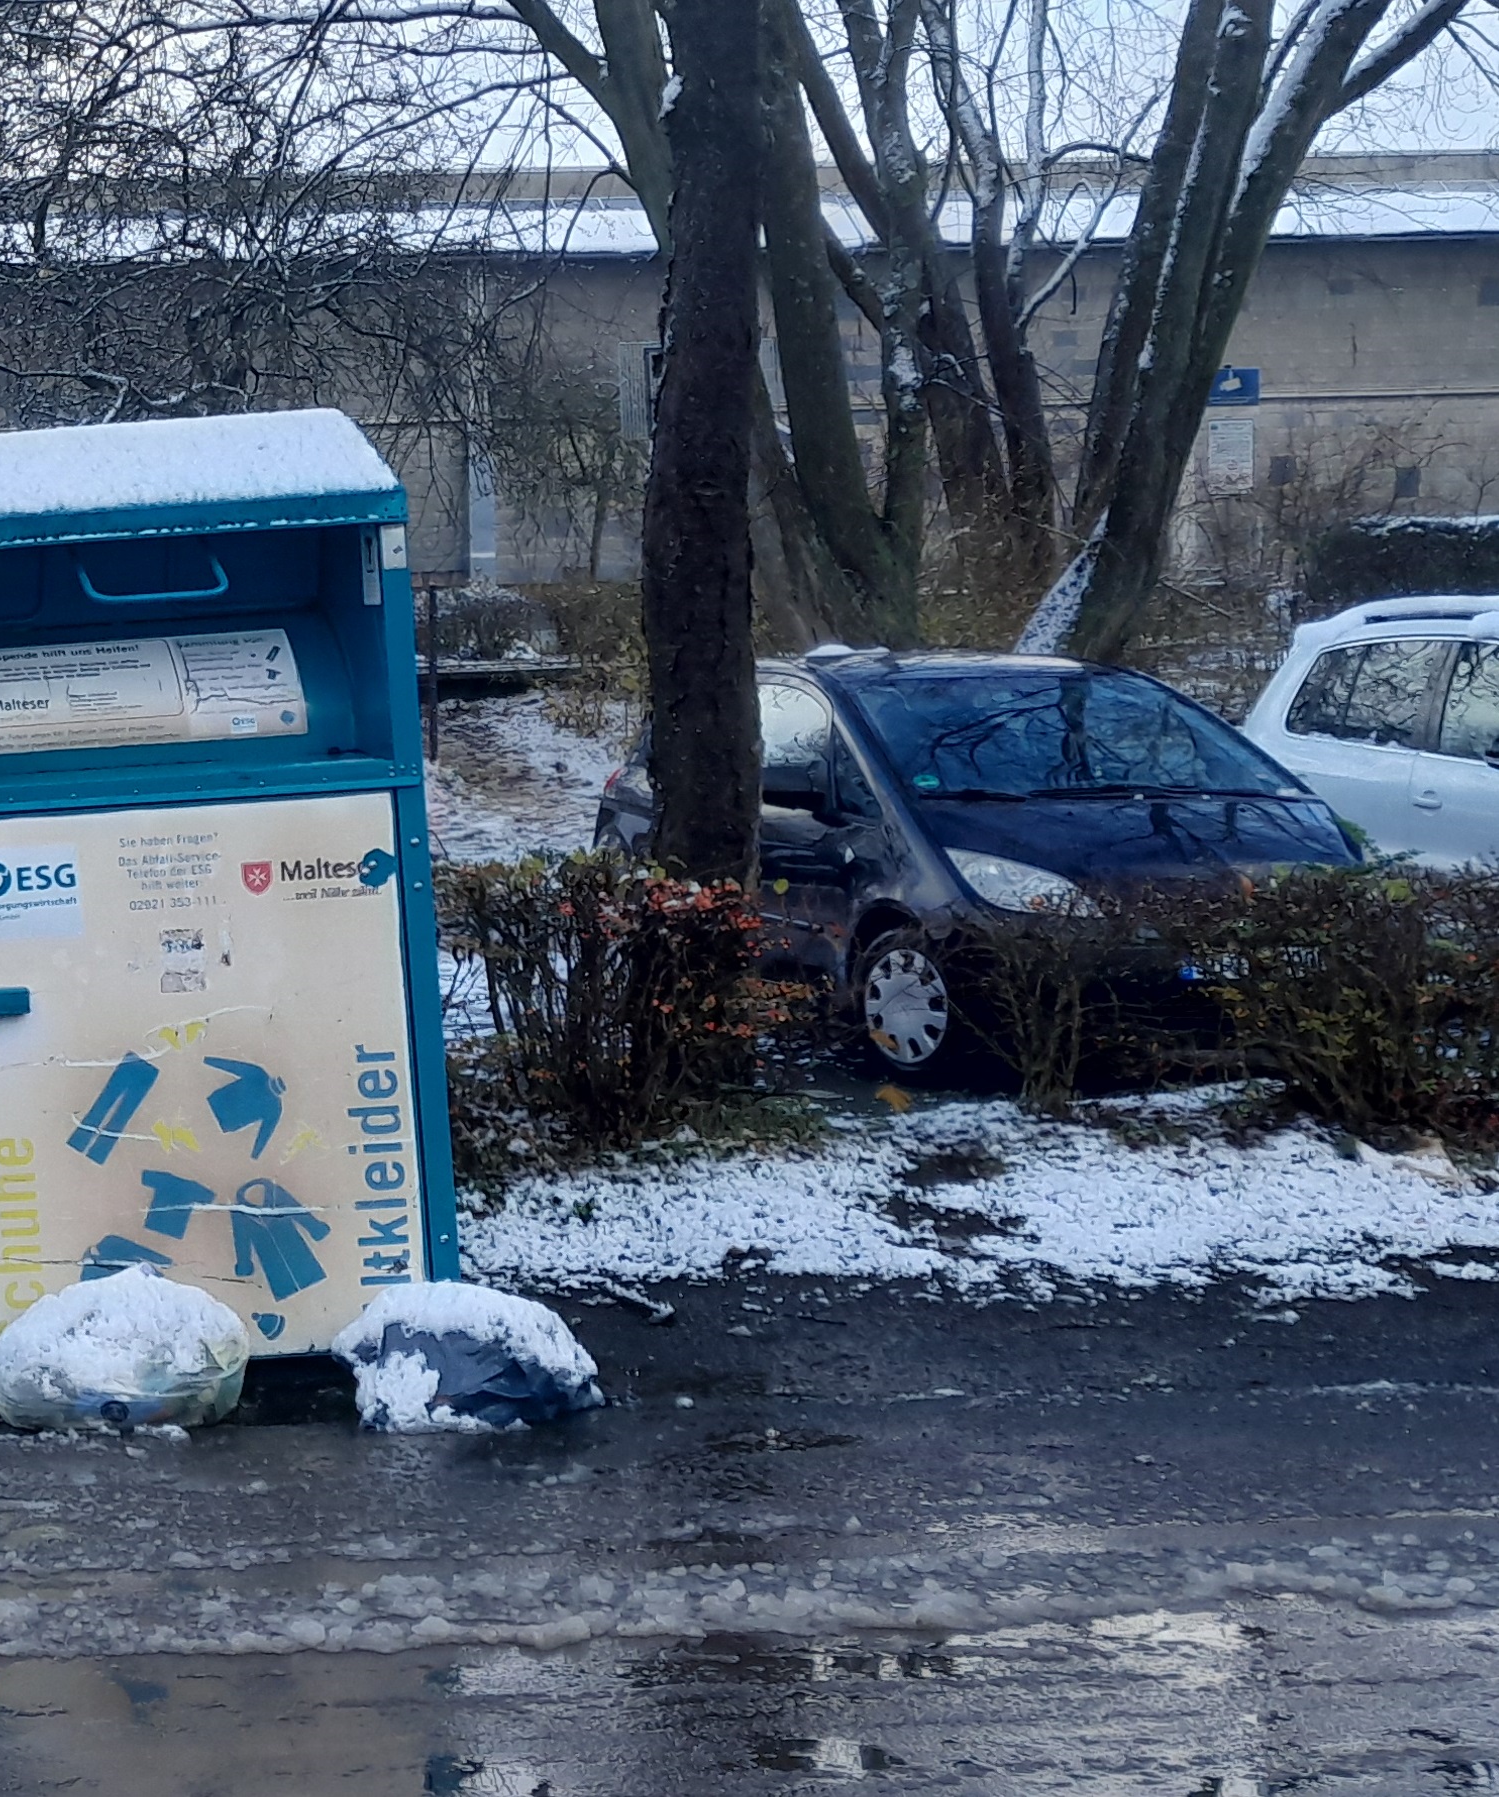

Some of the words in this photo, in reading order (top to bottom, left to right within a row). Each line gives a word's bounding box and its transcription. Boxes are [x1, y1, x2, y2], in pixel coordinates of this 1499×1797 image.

[119, 838, 137, 848] Sie
[140, 836, 173, 847] haben
[118, 856, 138, 867] Das
[127, 868, 167, 879] Telefon
[170, 866, 187, 877] der
[191, 864, 213, 875] ESG
[280, 857, 365, 882] Maltes
[16, 863, 77, 892] ESG
[166, 879, 199, 889] weiter
[347, 1043, 412, 1312] ltkleider
